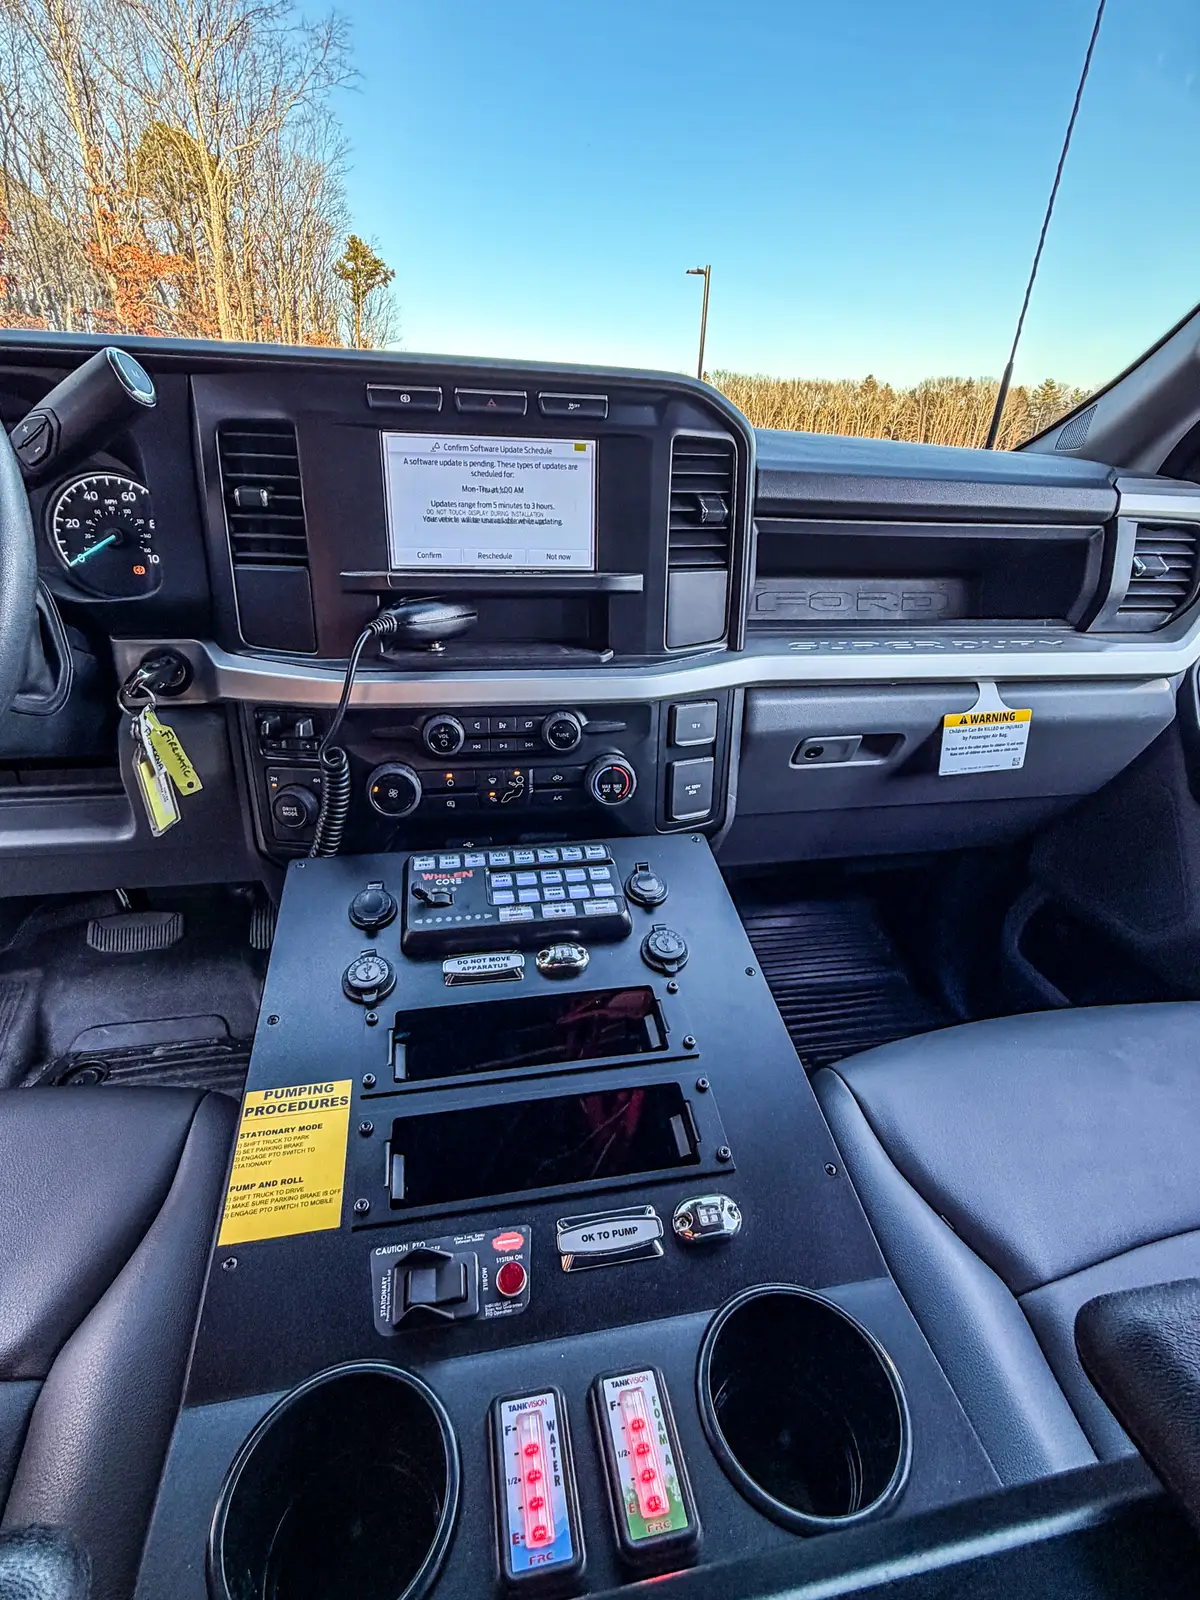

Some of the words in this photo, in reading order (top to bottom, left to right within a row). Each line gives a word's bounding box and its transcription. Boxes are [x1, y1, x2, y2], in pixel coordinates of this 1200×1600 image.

[444, 443, 469, 452] Confirm
[470, 444, 499, 452] Software
[500, 446, 523, 454] Update
[524, 446, 552, 454] Schedule
[410, 458, 438, 466] software
[439, 459, 462, 467] update
[469, 460, 496, 469] pending.
[497, 460, 516, 468] These
[517, 462, 534, 470] types
[542, 462, 568, 470] updates
[470, 470, 502, 478] scheduled
[504, 470, 515, 478] for:
[83, 491, 98, 501] 40
[121, 492, 136, 502] 60
[430, 500, 457, 508] Updates
[458, 501, 476, 509] range
[66, 519, 80, 528] 20
[756, 591, 949, 612] FORD
[970, 712, 1016, 724] WARNING
[421, 870, 473, 880] WHELEN
[461, 963, 508, 972] APPARATUS
[263, 1083, 334, 1100] PUMPING
[244, 1095, 349, 1118] PROCEDURES
[240, 1126, 296, 1139] STATIONARY
[298, 1123, 324, 1132] MODE
[262, 1137, 284, 1145] TRUCK
[255, 1144, 283, 1153] PARKING
[241, 1153, 267, 1162] ENGAGE
[234, 1160, 272, 1169] STATIONARY
[229, 1183, 256, 1192] PUMP
[258, 1180, 278, 1188] AND
[280, 1177, 304, 1186] ROLL
[232, 1193, 251, 1202] SHIFT
[253, 1190, 274, 1199] TRUCK
[270, 1194, 298, 1204] PARKING
[300, 1190, 321, 1200] BRAKE
[230, 1208, 258, 1218] ENGAGE
[274, 1202, 299, 1211] SWITCH
[310, 1197, 333, 1206] MOBILE
[581, 1234, 595, 1243] OK
[597, 1232, 610, 1240] TO
[612, 1227, 639, 1237] PUMP
[375, 1244, 409, 1256] CAUTION
[412, 1241, 426, 1250] PTO
[611, 1375, 649, 1388] TANKVISION
[508, 1398, 548, 1412] TANKVISION
[610, 1401, 617, 1411] F
[505, 1426, 512, 1436] F
[652, 1396, 667, 1445] FOAM
[665, 1454, 672, 1466] A
[546, 1420, 560, 1486] WATER
[617, 1450, 628, 1458] 1/2
[508, 1477, 518, 1486] 1/2
[628, 1503, 636, 1514] E
[647, 1520, 671, 1533] FRC
[512, 1533, 520, 1545] E
[529, 1552, 554, 1566] FRC
